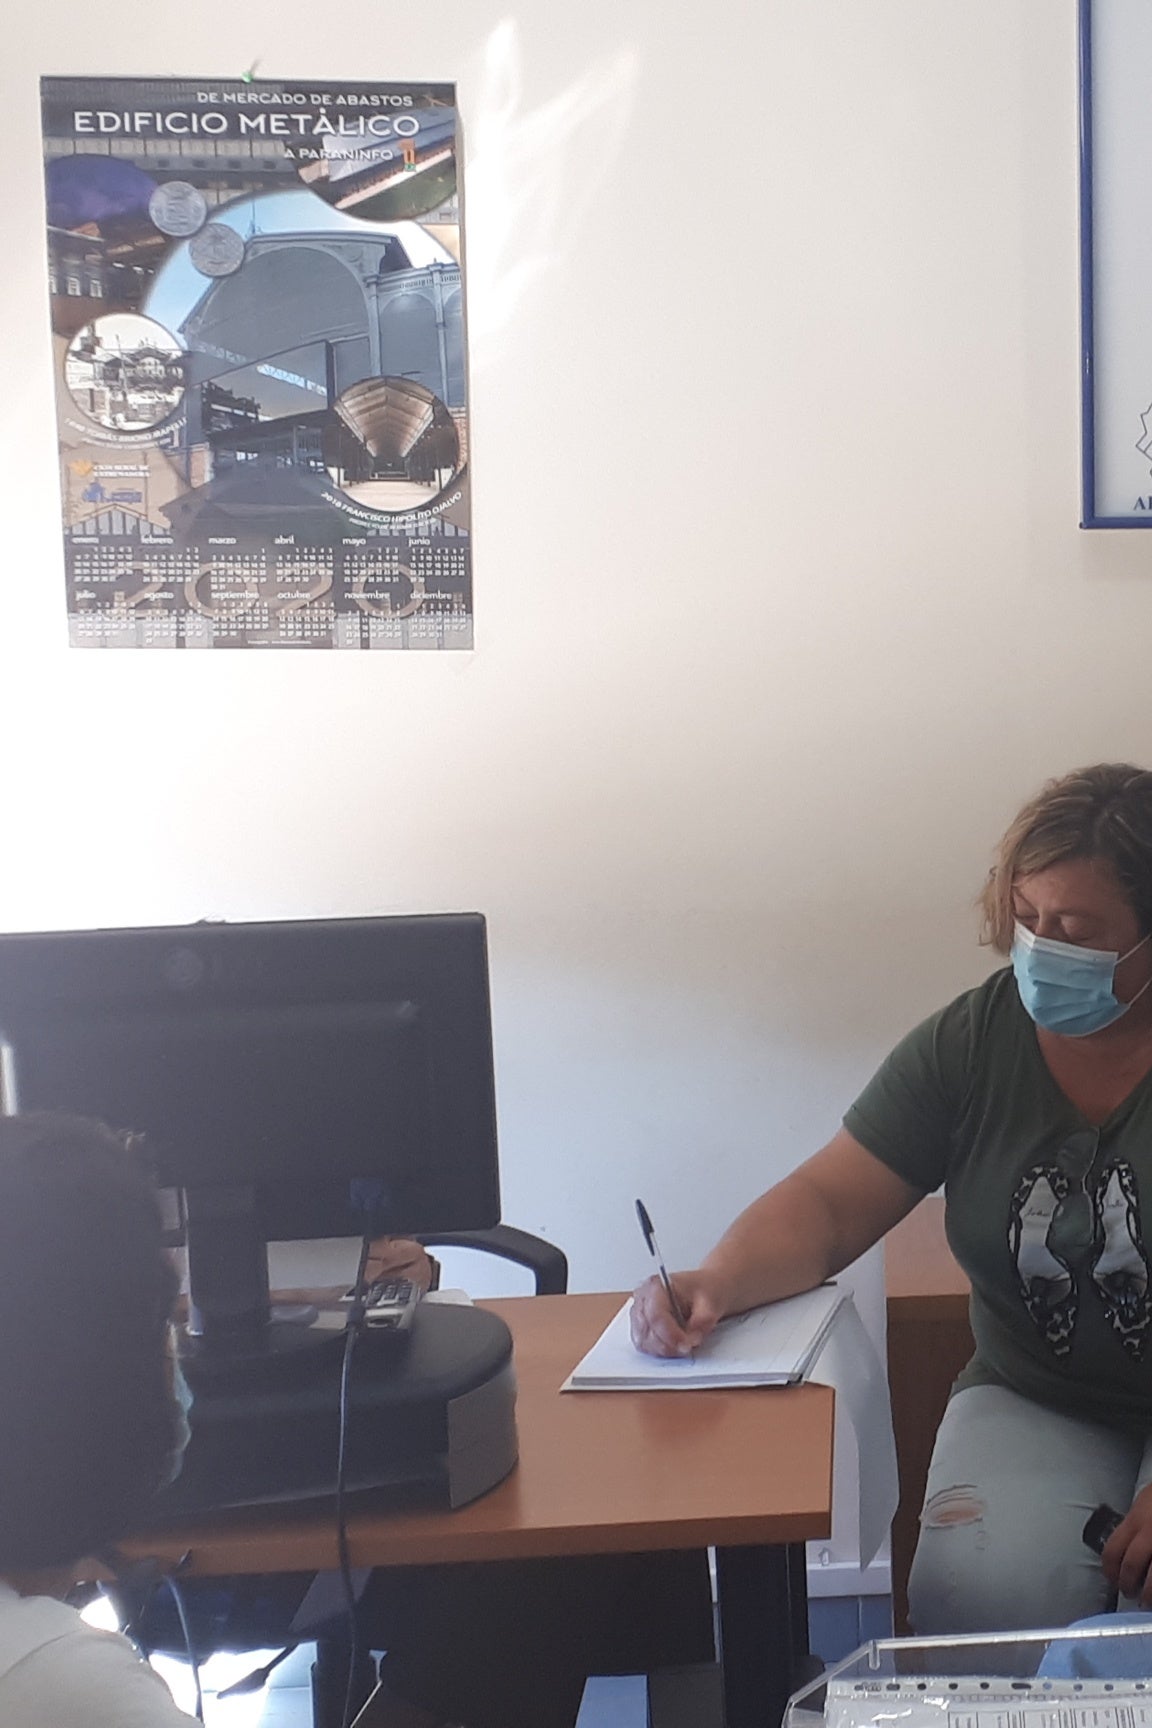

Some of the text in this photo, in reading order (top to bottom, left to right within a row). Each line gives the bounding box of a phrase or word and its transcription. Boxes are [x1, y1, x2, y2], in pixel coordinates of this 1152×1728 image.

[197, 92, 413, 107] DE MERCADO DE ABASTOS
[74, 111, 228, 134] EDIFICIO
[284, 149, 394, 160] A PARANINFO
[341, 503, 391, 522] FRANCISCO
[432, 491, 462, 514] OJALVO
[275, 535, 295, 544] abril
[342, 538, 366, 547] mayo
[408, 537, 430, 547] junio
[211, 590, 259, 601] septiembre
[277, 590, 311, 599] octubre
[344, 590, 390, 599] noviembre
[410, 590, 452, 599] diciembre
